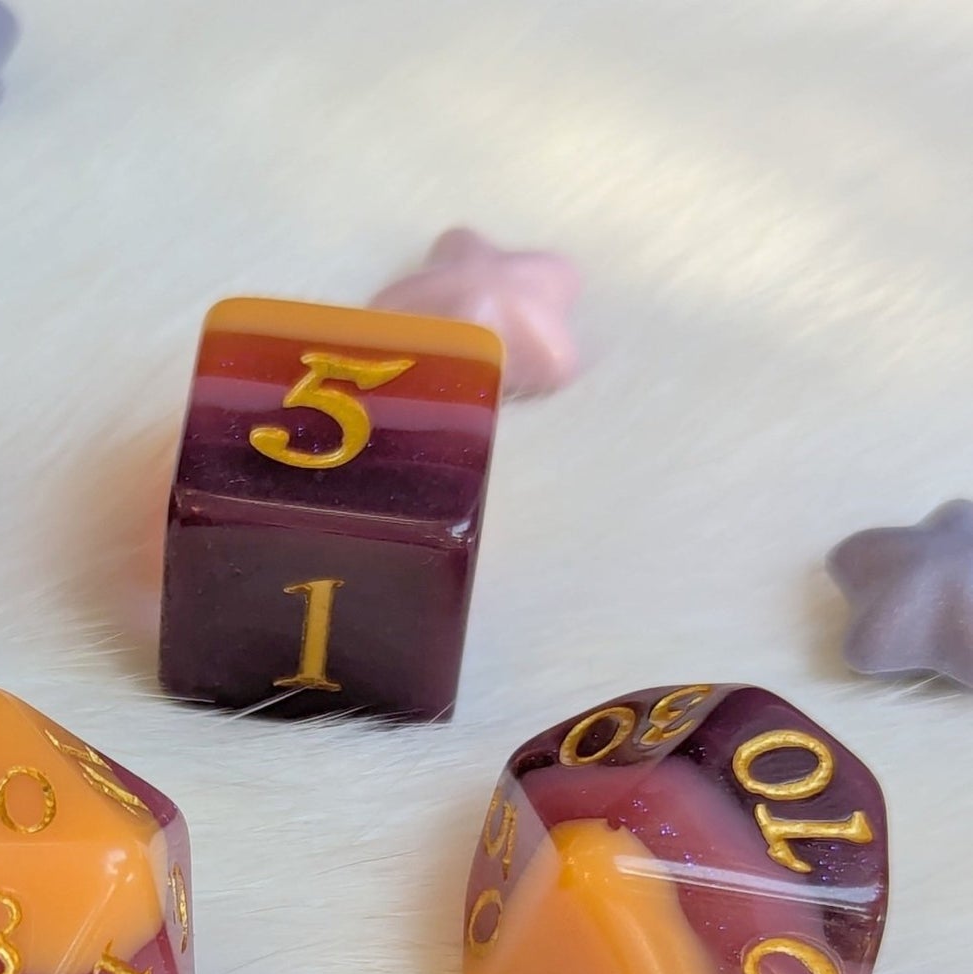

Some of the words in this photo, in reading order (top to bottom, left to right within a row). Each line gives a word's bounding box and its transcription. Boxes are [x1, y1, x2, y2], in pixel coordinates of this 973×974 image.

[249, 352, 417, 469] 5
[272, 578, 345, 693] 1
[559, 685, 712, 767] 30
